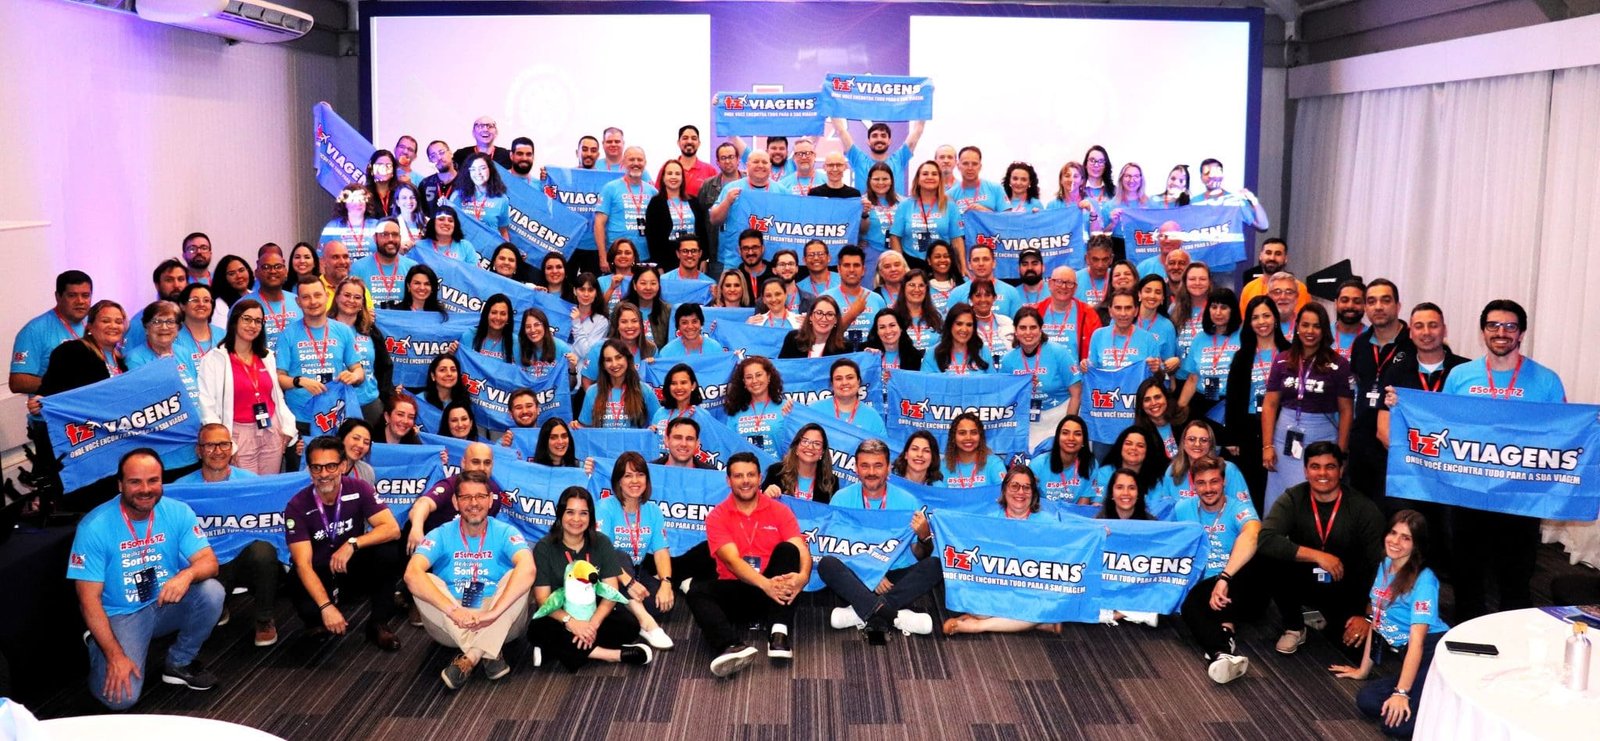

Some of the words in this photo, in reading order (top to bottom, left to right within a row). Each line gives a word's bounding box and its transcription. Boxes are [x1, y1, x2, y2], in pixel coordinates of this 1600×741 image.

[832, 77, 852, 92] tz
[856, 82, 921, 95] VIAGENS
[724, 96, 744, 110] tz
[749, 98, 814, 110] VIAGENS
[326, 142, 367, 185] VIAGEN
[559, 191, 597, 205] VIAG
[509, 206, 566, 248] VIAGENS
[749, 214, 769, 233] tz
[774, 221, 847, 237] VIAGENS
[1002, 234, 1070, 251] VIAGENS
[1134, 230, 1156, 246] tz
[441, 285, 486, 314] VIAG
[385, 336, 407, 355] tz
[412, 342, 450, 356] VIAG
[299, 353, 334, 361] Sonos
[461, 373, 480, 395] tz
[487, 387, 554, 405] VINS
[785, 385, 868, 406] VIAGS
[1092, 388, 1114, 409] tz
[1469, 385, 1524, 398] #SooTZ
[900, 399, 924, 419] tz
[65, 422, 95, 446] tz
[1407, 427, 1440, 458] tz
[1449, 438, 1579, 471] VIAGENS
[1405, 455, 1423, 466] ONDE
[1424, 458, 1442, 470] VOCÊ
[1443, 463, 1483, 476] ENCONTRA
[1484, 467, 1505, 478] TUDO
[1506, 470, 1526, 480] PARA
[1535, 472, 1552, 482] SUA
[1553, 474, 1581, 485] VIAGEM
[376, 478, 427, 495] GENS
[196, 512, 286, 529] VIAGEN
[659, 501, 715, 521] AGEN
[613, 540, 647, 548] Sonos
[944, 544, 972, 571] tz
[980, 555, 1083, 583] VIAGENS
[975, 575, 1008, 586] ENCONTRA
[1009, 579, 1026, 588] TUDO
[1027, 581, 1043, 590] PARA
